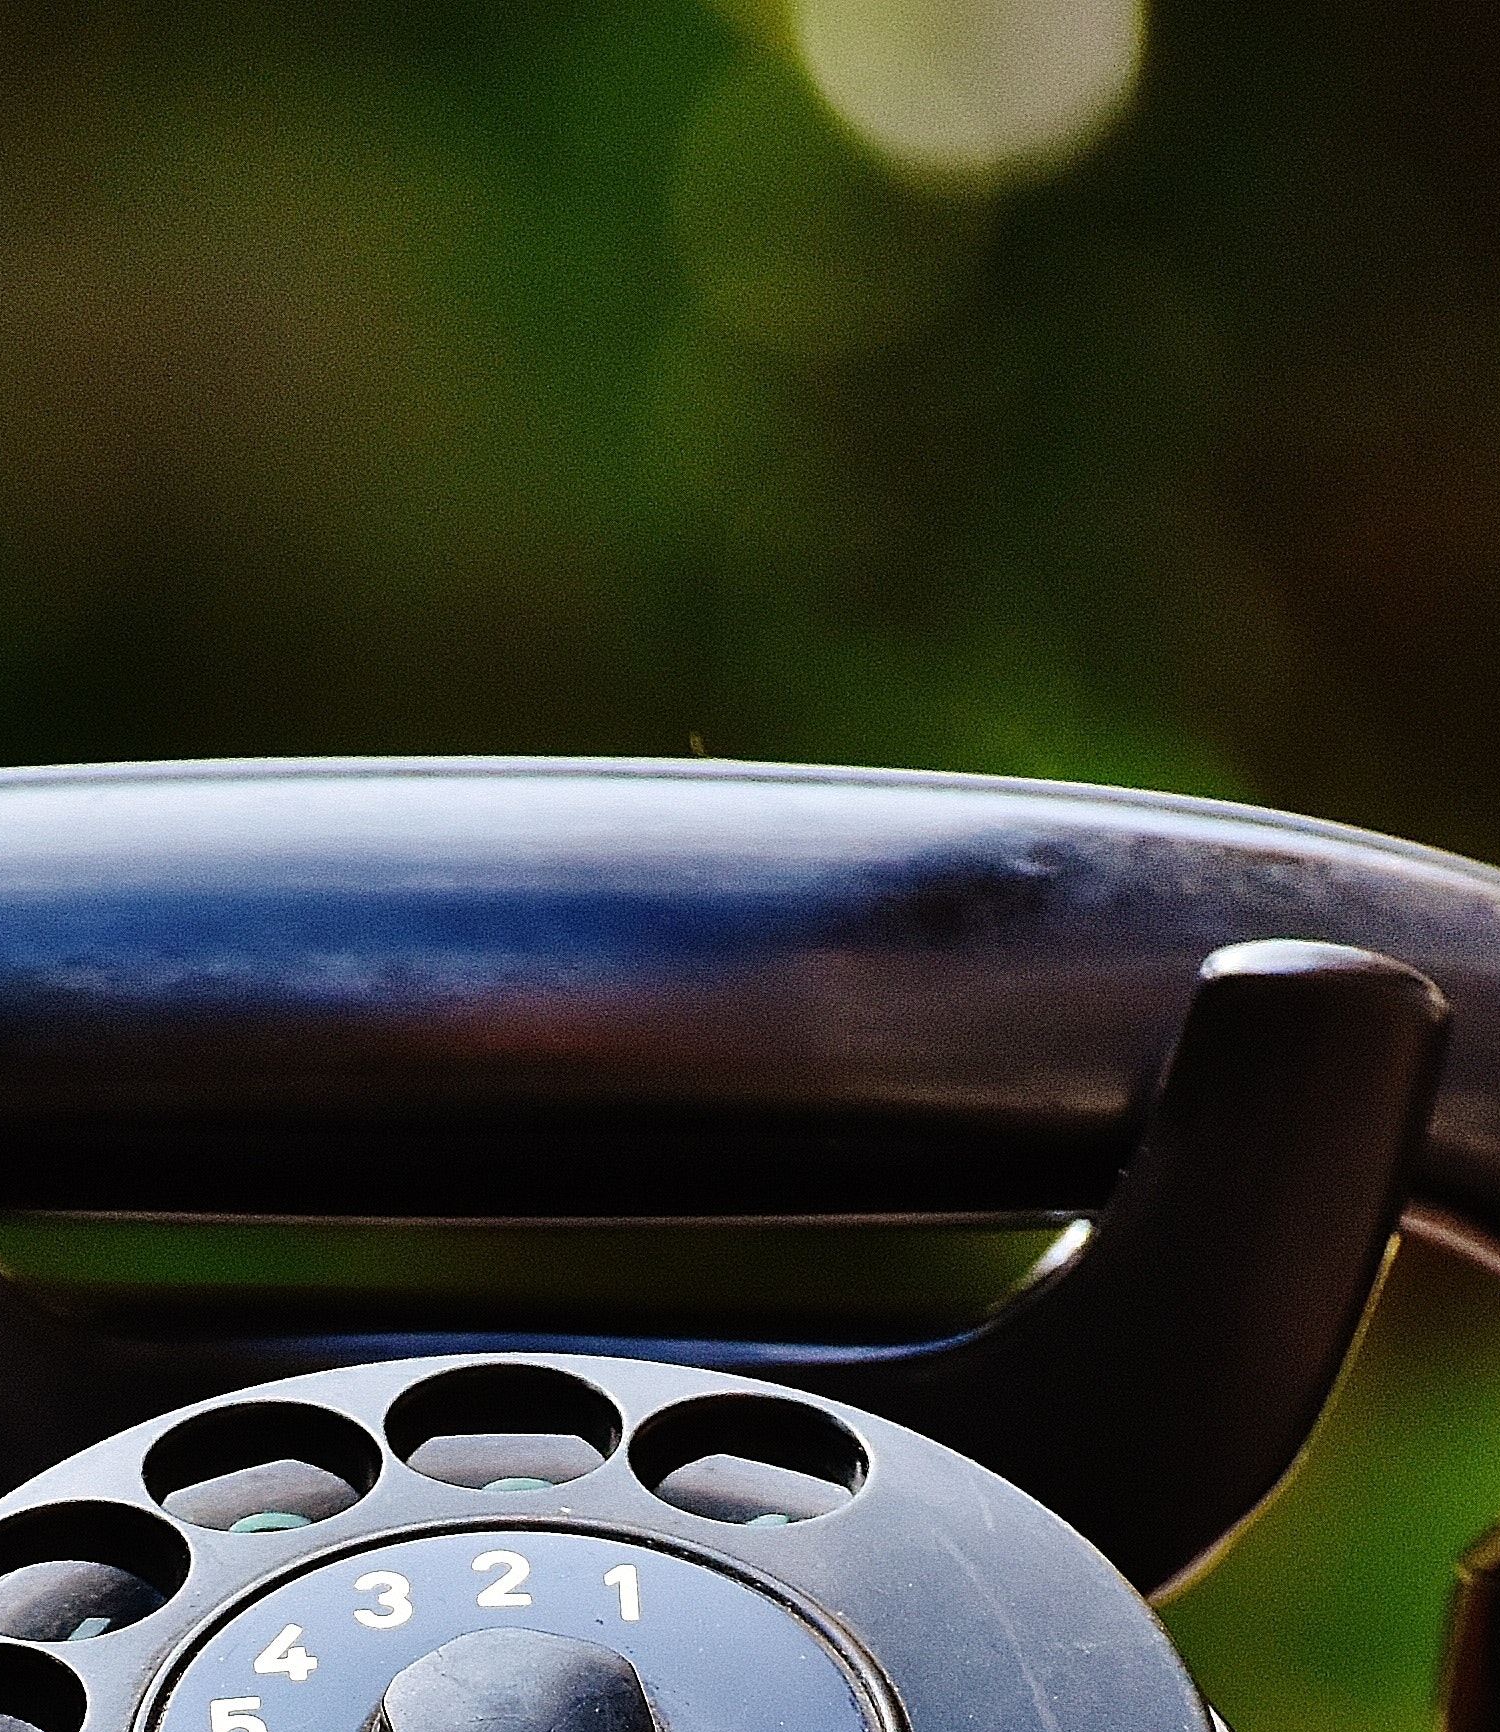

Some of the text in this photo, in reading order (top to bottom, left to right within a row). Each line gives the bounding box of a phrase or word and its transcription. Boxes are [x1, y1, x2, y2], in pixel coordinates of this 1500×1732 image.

[354, 1570, 413, 1629] 3
[472, 1550, 532, 1607] 2
[604, 1564, 640, 1622] 1
[254, 1623, 318, 1681] 4
